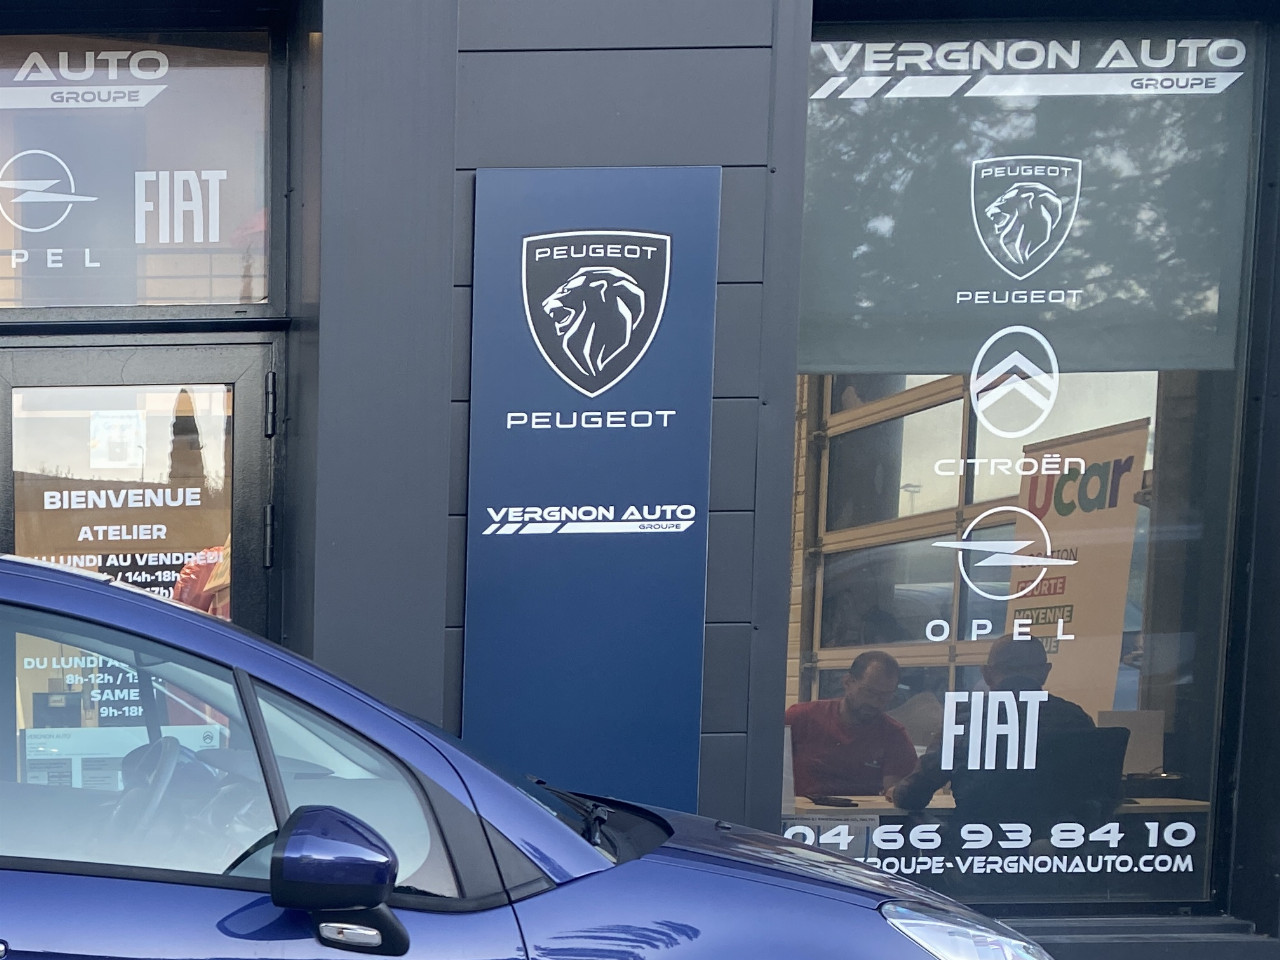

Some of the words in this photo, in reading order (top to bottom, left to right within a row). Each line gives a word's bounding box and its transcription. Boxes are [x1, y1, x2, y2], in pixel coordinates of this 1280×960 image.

[821, 41, 1081, 71] VERGNON
[1095, 39, 1247, 68] AUTO
[14, 50, 169, 81] AUTO
[1130, 77, 1216, 90] GROUPE
[50, 90, 140, 104] GROUPE
[981, 166, 1072, 178] PEUGEOT
[134, 170, 226, 244] FIAT
[535, 244, 658, 262] PEUGEOT
[956, 289, 1083, 304] PEUGEOT
[506, 410, 676, 430] PEUGEOT
[43, 487, 201, 510] BIENVENUE
[486, 506, 615, 522] VERGNON
[621, 505, 695, 520] AUTO
[77, 524, 167, 542] ATELIER
[106, 553, 132, 567] AU
[134, 551, 224, 567] VENDREDI
[125, 570, 180, 583] 14h-18h
[925, 618, 1075, 642] OPEL
[23, 657, 48, 669] DU
[51, 655, 103, 669] LUNDI
[66, 672, 113, 685] 8h-12h
[940, 690, 1049, 770] FIAT
[783, 824, 855, 850] 04
[872, 824, 942, 850] 66
[960, 823, 1032, 849] 93
[1050, 822, 1125, 848] 84
[1144, 821, 1196, 848] 10
[854, 854, 1194, 875] ROUPE-VERGNONAUTO.COM
